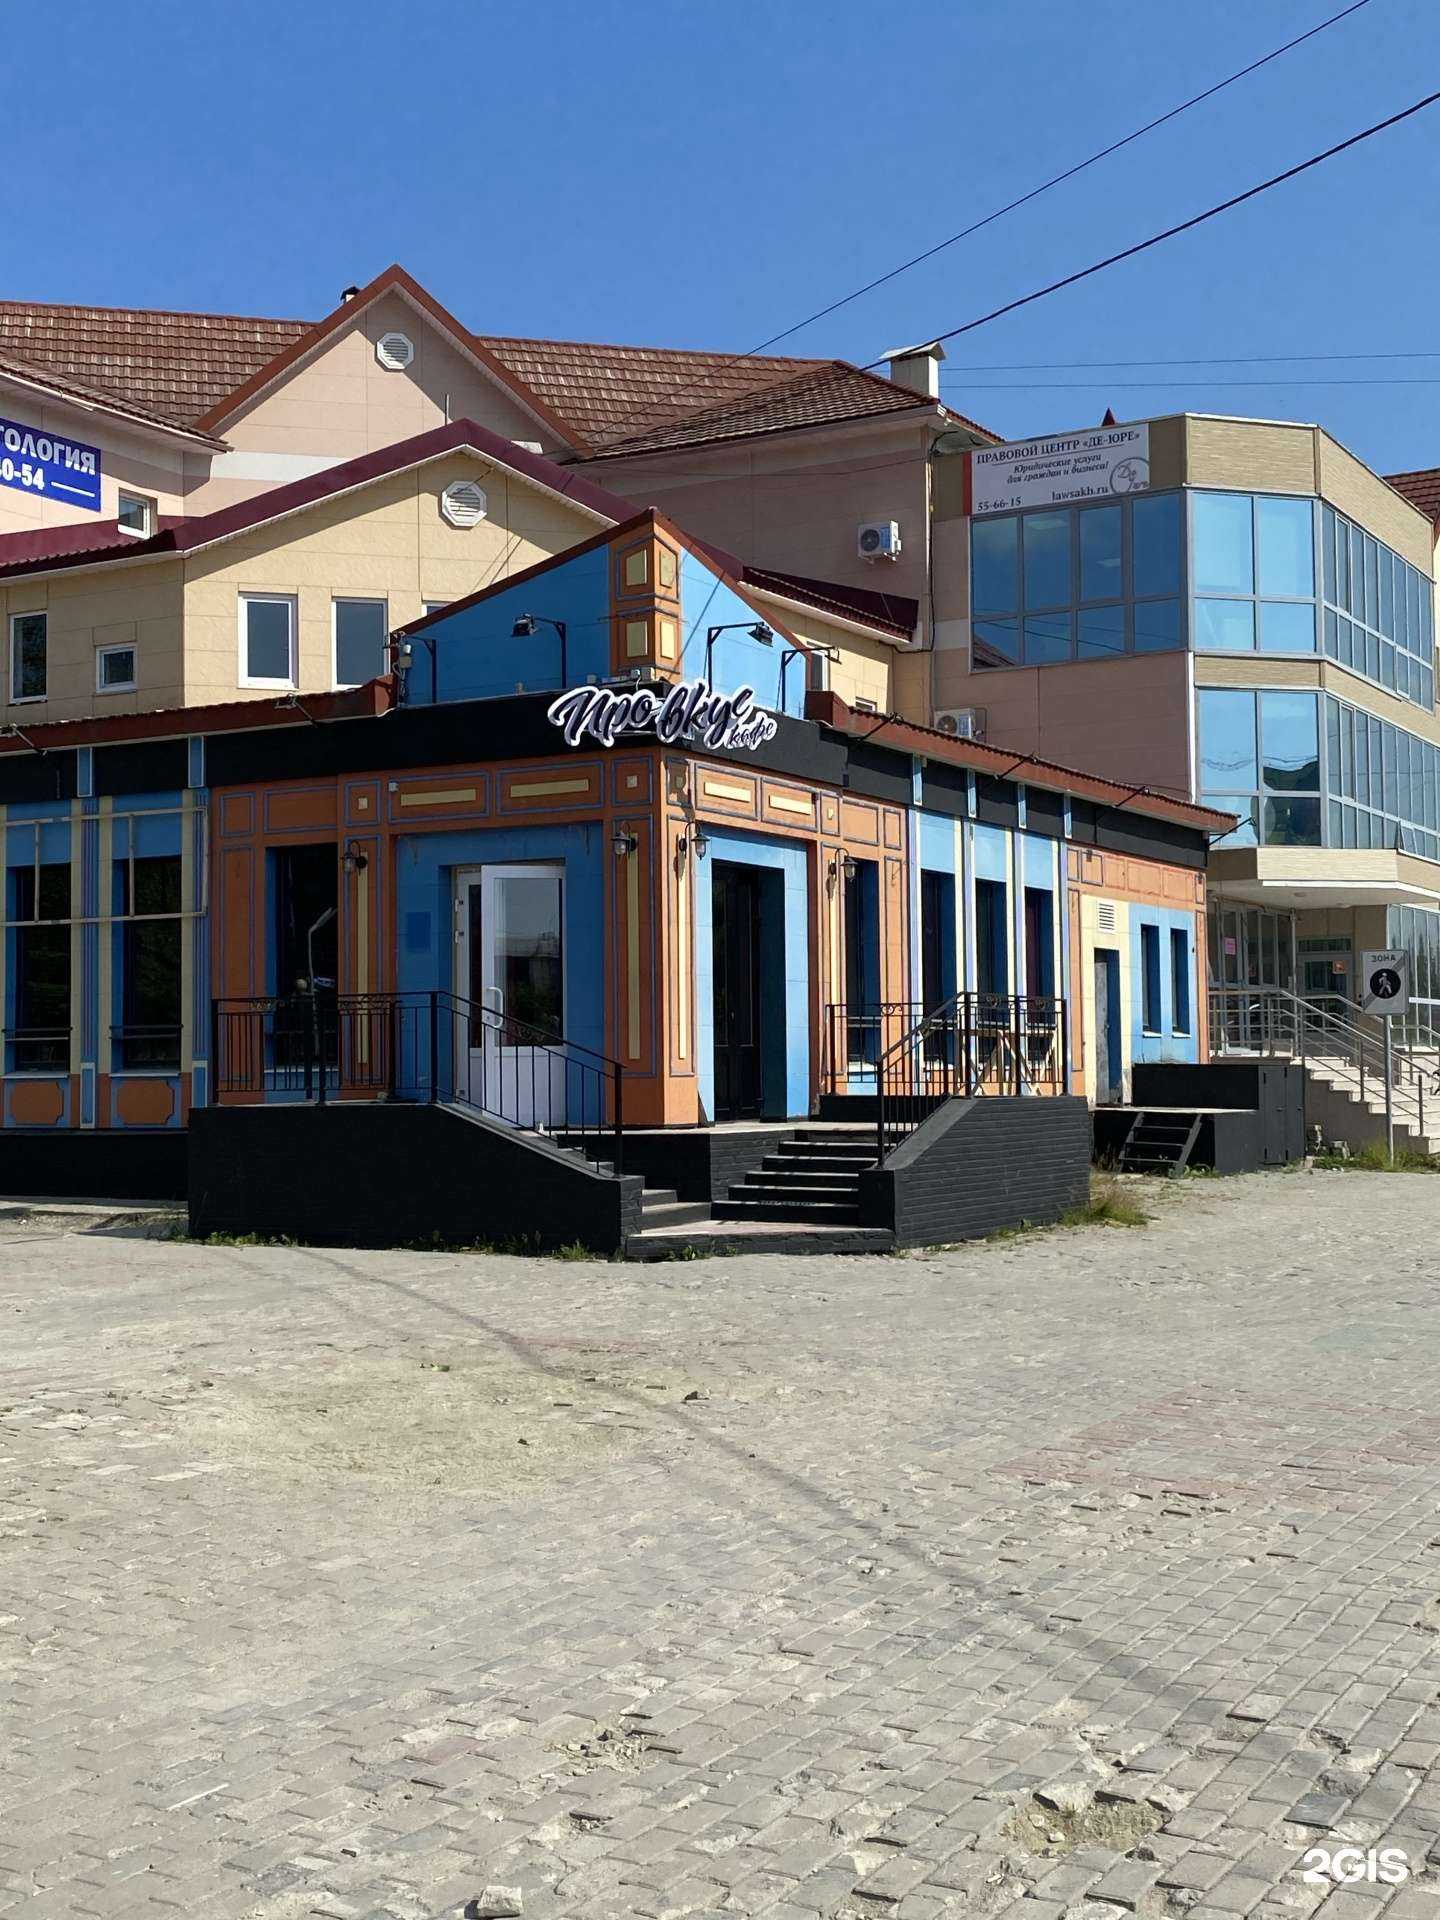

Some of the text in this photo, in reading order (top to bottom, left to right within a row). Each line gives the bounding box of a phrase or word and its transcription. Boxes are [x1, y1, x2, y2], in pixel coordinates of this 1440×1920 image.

[0, 425, 96, 475] ОЛОГИЯ
[976, 445, 1038, 464] ПРАВОВОЙ
[1041, 439, 1080, 455] ЦЕНТР
[1013, 453, 1102, 474] Юридические услуги
[0, 456, 45, 490] 0-54
[1023, 469, 1062, 482] граждан
[1052, 485, 1109, 501] lawsakh.ru
[977, 497, 1022, 512] 55-66-15
[1371, 954, 1396, 963] ЗОНА
